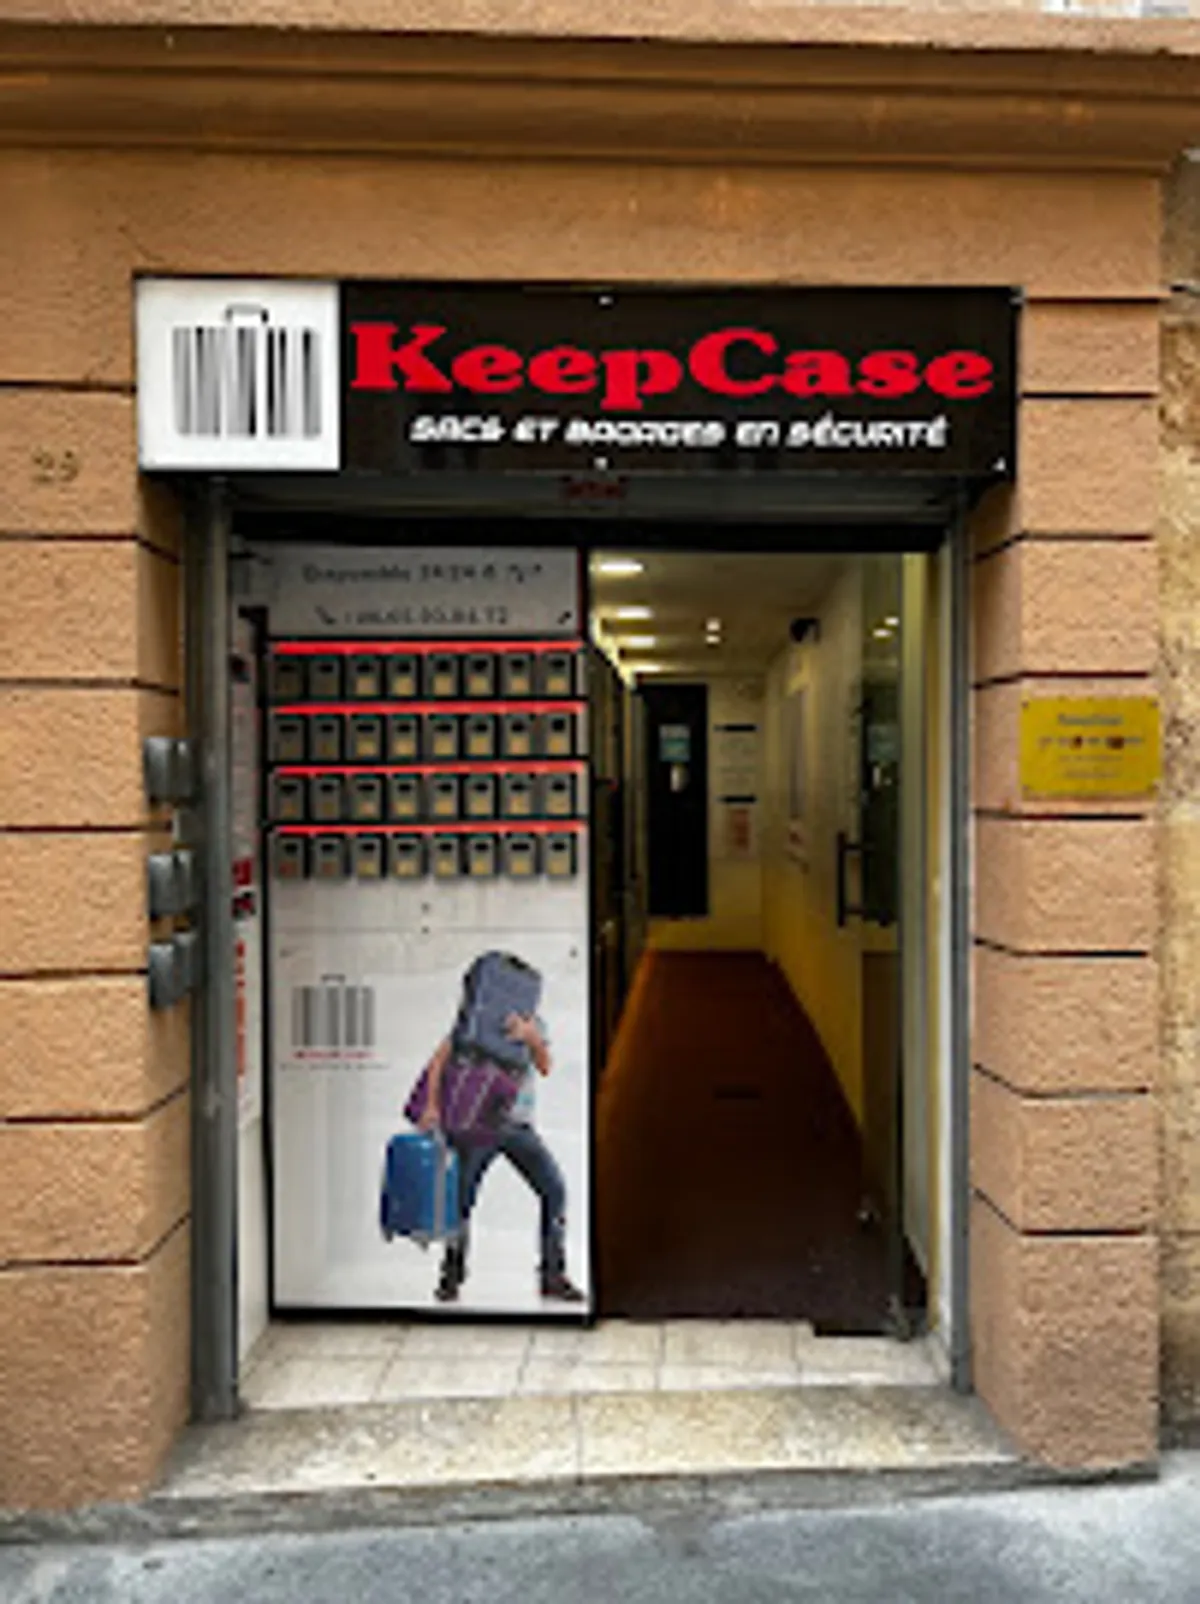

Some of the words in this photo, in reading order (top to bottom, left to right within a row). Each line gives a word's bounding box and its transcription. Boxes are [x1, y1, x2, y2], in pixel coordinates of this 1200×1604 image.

[350, 322, 996, 410] KeepCase
[511, 416, 560, 443] ET
[785, 409, 949, 449] SÉCURITÉ
